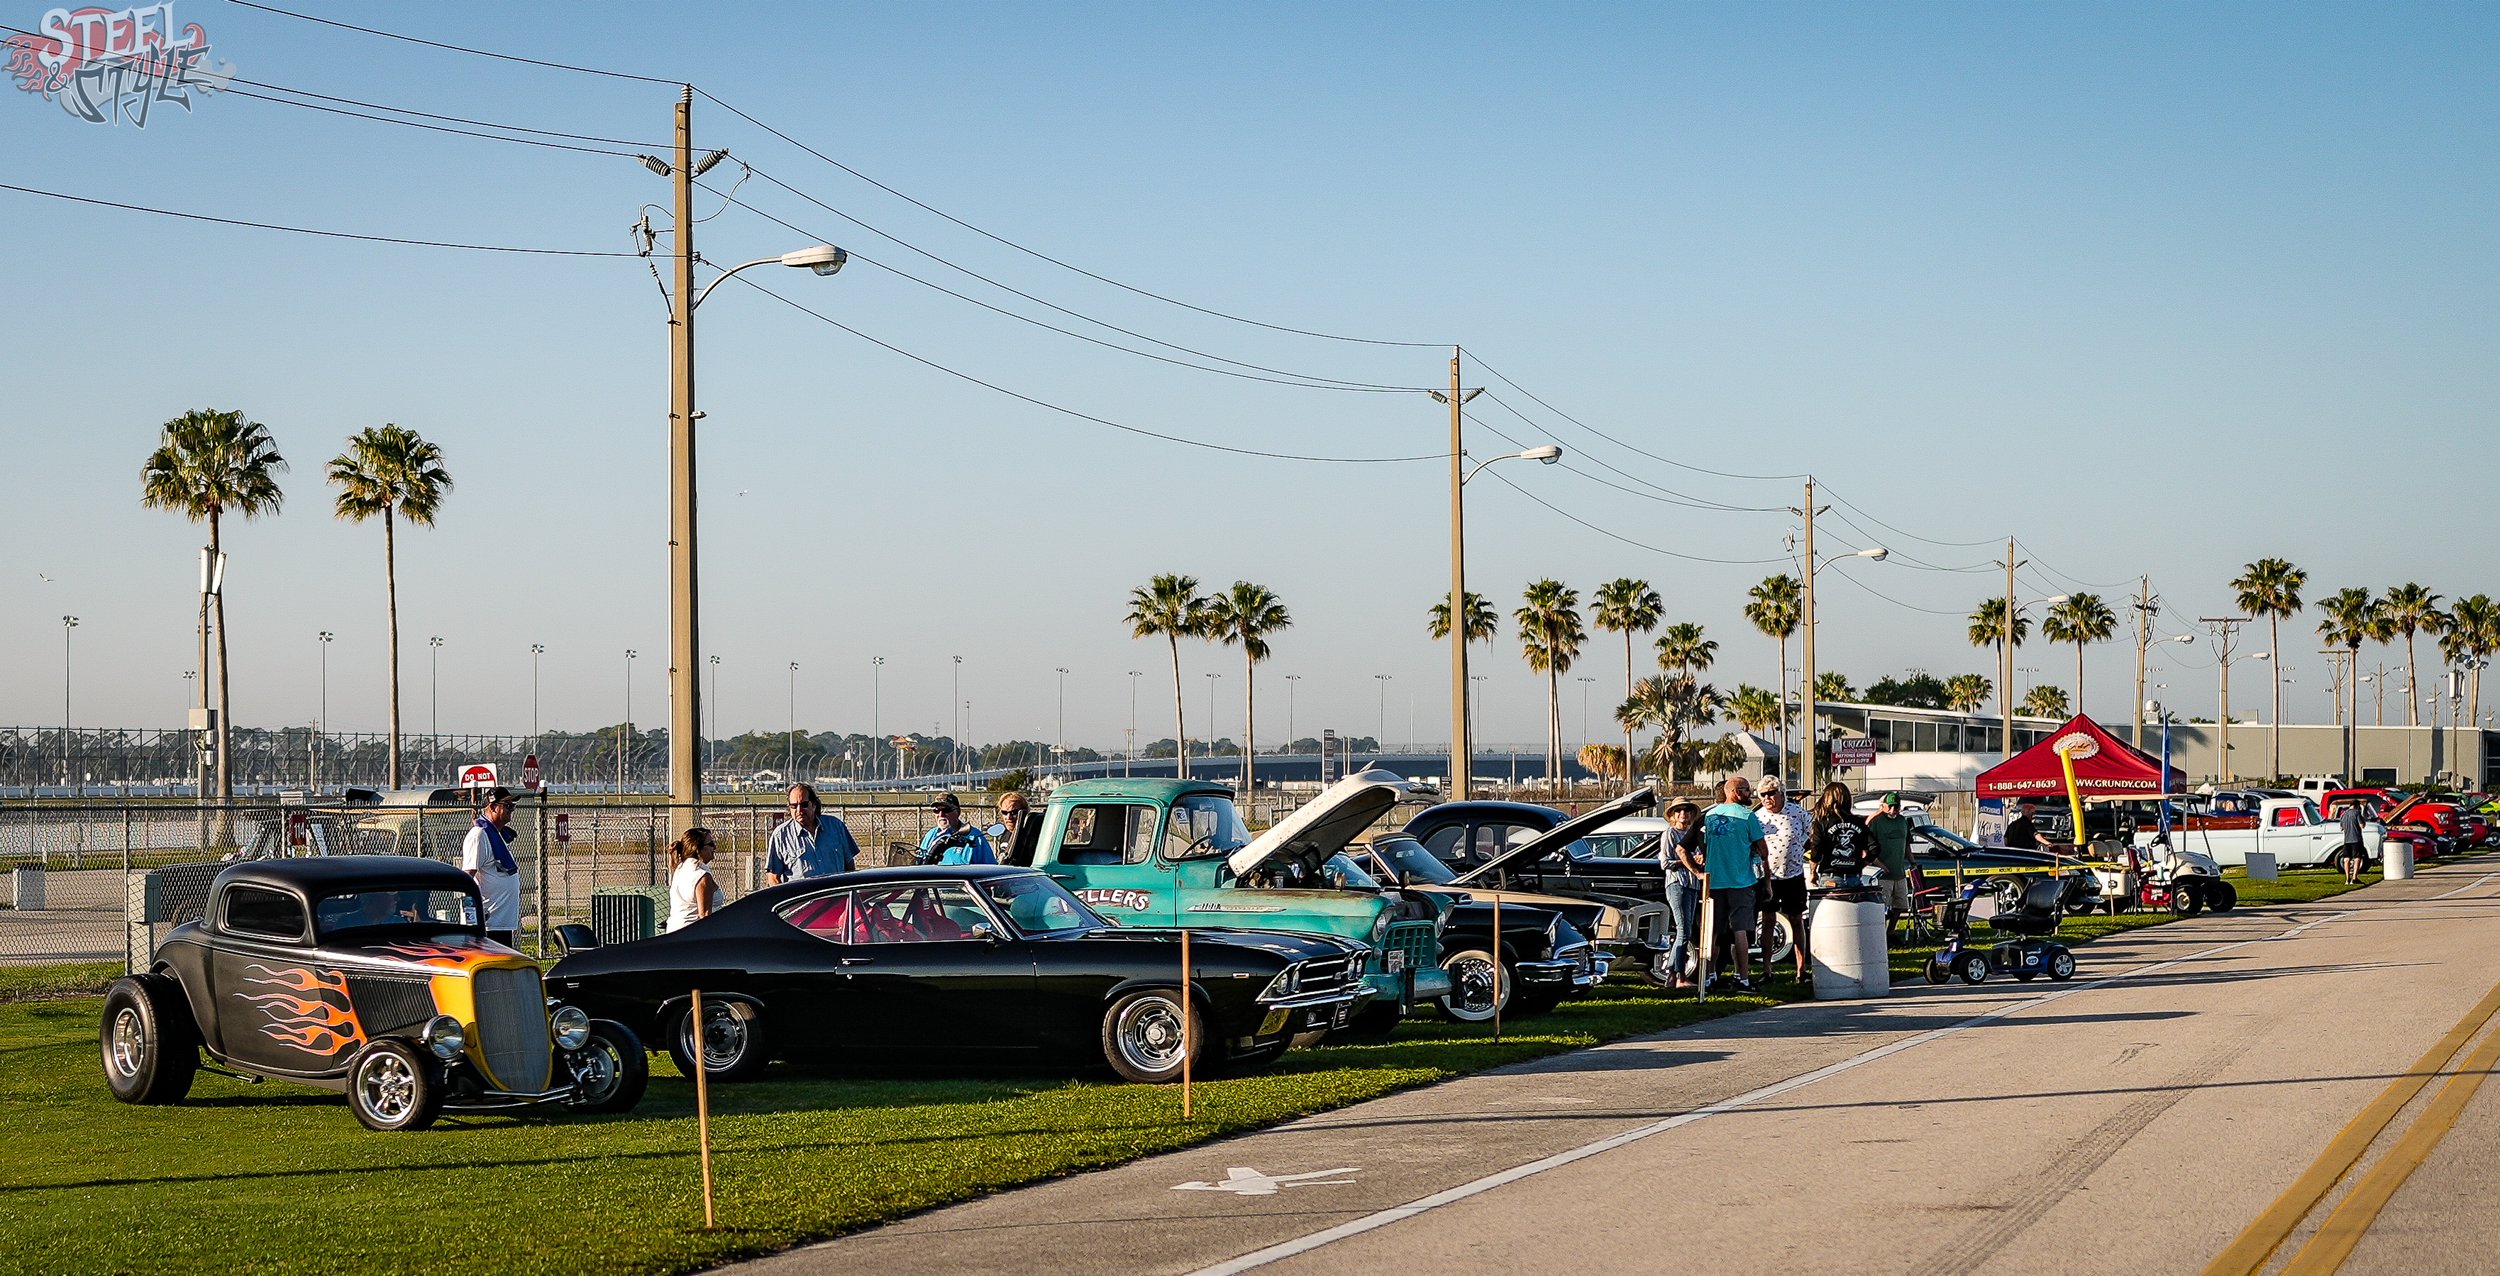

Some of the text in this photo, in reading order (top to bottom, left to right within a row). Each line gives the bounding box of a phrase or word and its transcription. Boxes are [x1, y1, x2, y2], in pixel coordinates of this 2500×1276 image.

[1842, 739, 1873, 749] GRIZZLY
[464, 772, 491, 782] DO NOT
[524, 767, 539, 783] STOP
[2075, 779, 2157, 789] WW.GRUNDY.COM
